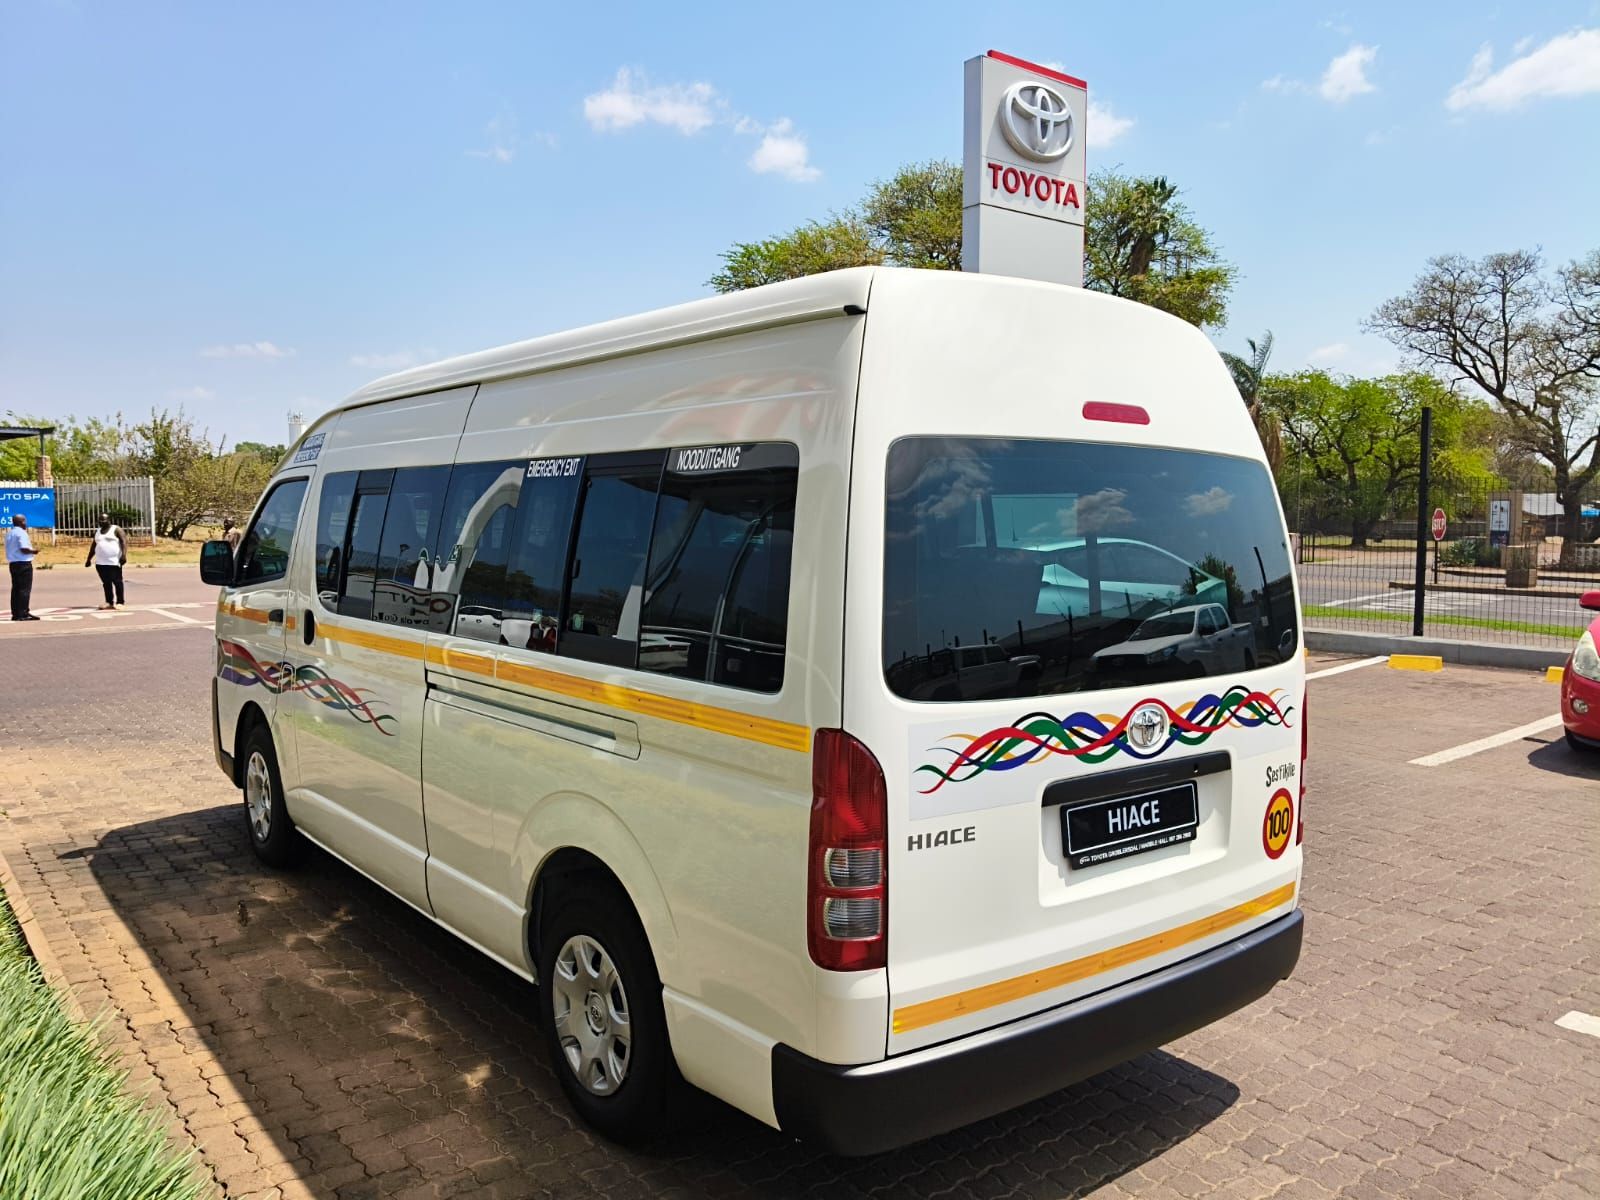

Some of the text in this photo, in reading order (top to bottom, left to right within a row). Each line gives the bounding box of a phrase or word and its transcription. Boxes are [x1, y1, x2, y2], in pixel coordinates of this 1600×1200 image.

[988, 162, 1079, 208] TOYOTA
[526, 458, 580, 477] EMERGENCY EXIT
[676, 446, 741, 471] NOODUITGANG
[1432, 518, 1446, 530] STOP
[1108, 800, 1160, 834] HIACE
[1268, 807, 1290, 840] 100
[907, 825, 976, 851] HIACE
